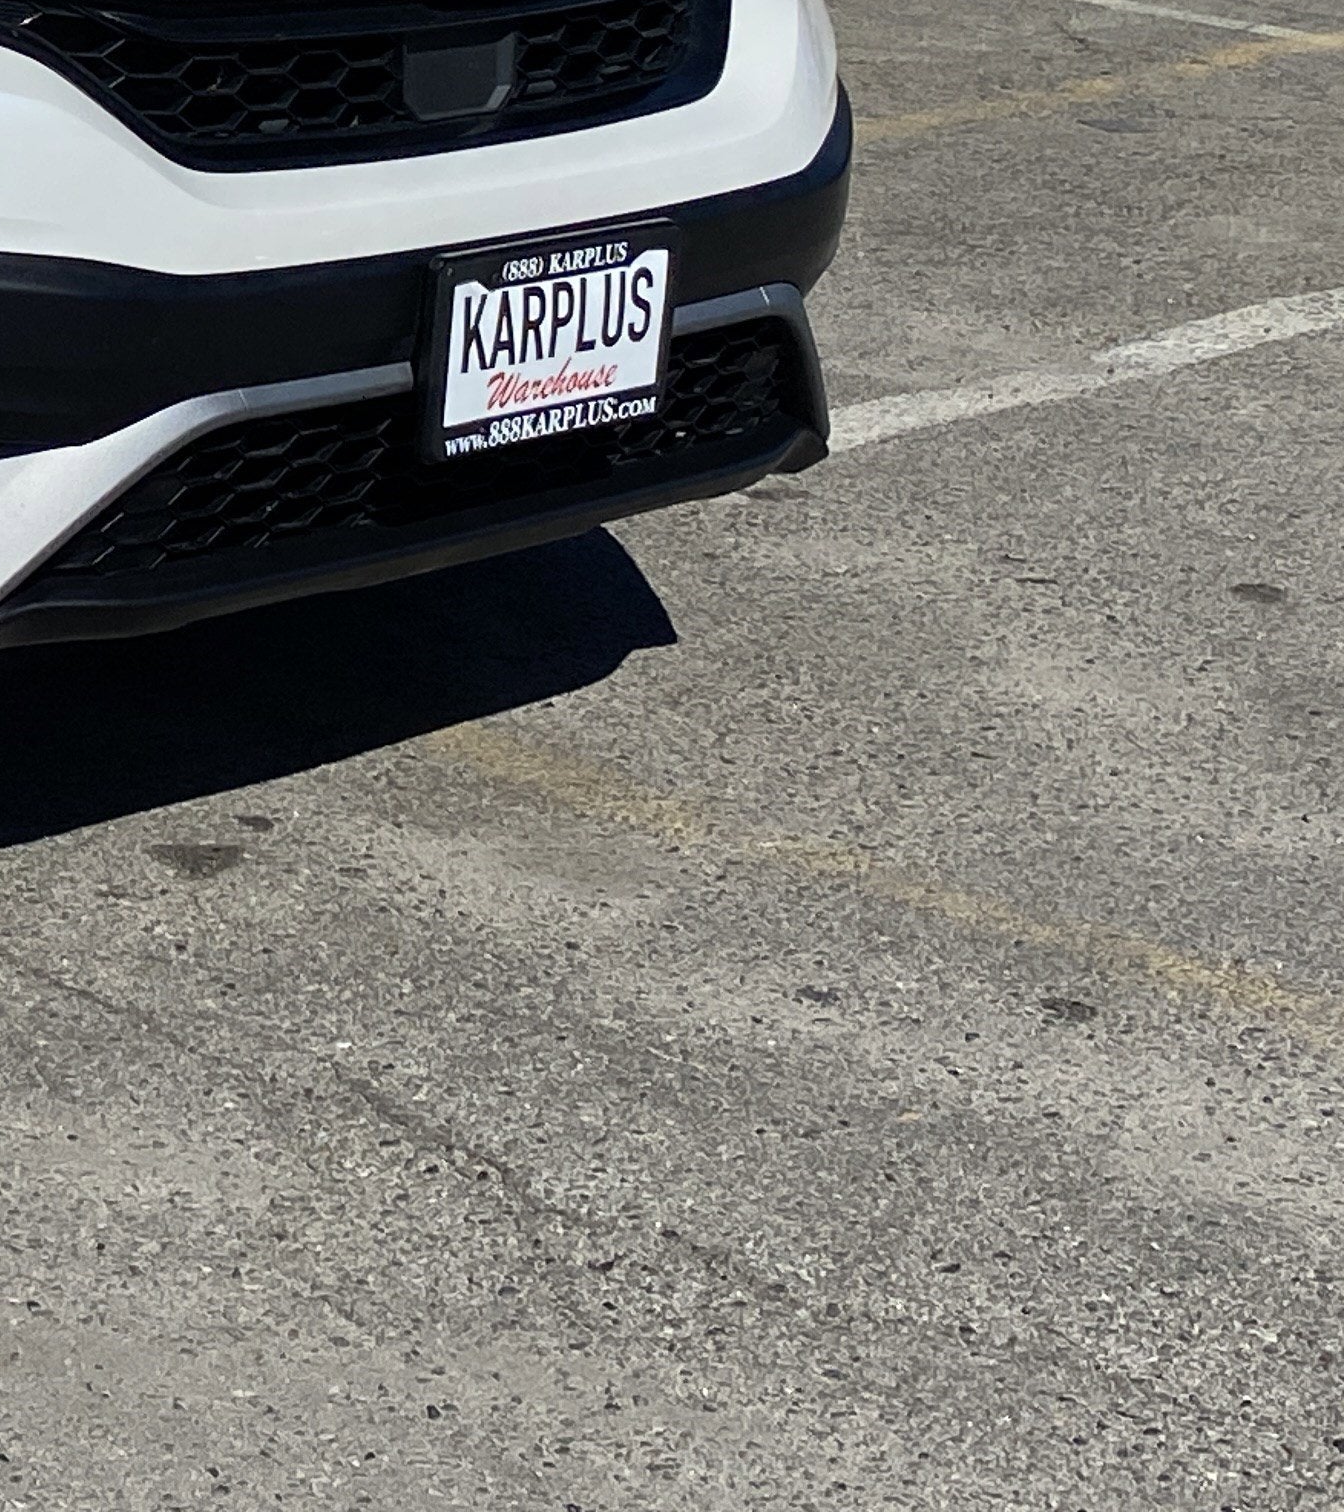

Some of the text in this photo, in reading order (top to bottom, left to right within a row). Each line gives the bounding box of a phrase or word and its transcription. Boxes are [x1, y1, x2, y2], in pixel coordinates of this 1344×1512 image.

[502, 241, 629, 282] (888) KARPLUS
[460, 266, 654, 374] KARPLUS
[485, 356, 619, 411] Warehouse
